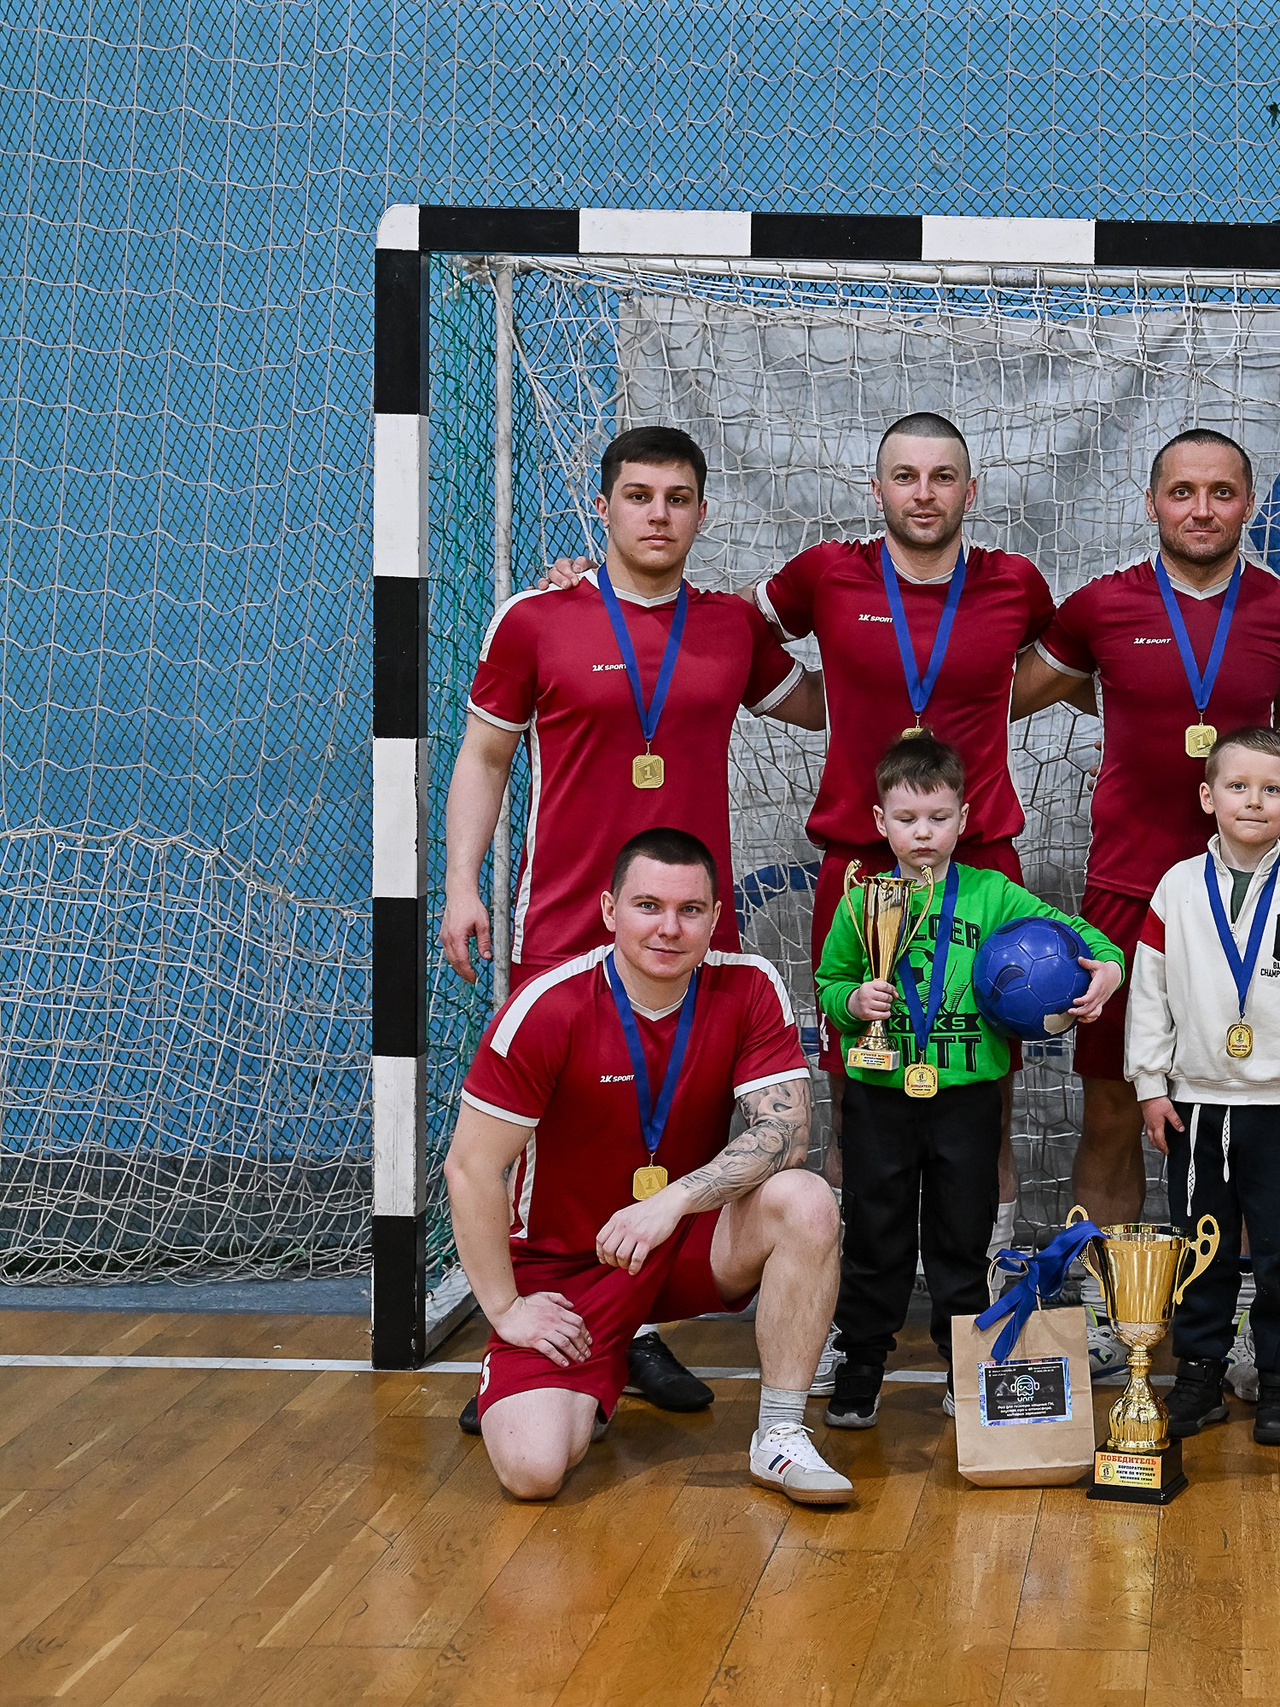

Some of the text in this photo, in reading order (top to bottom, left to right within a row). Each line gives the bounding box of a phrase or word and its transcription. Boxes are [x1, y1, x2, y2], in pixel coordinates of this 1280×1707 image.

[858, 614, 893, 623] 2K SPORT
[592, 664, 604, 672] 2K
[910, 913, 981, 951] CCER
[889, 1017, 966, 1031] KIKS
[888, 1034, 982, 1073] UTT
[600, 1074, 635, 1083] 2K SPORT
[1100, 1454, 1157, 1466] ПОБЕДИТЕЛЬ
